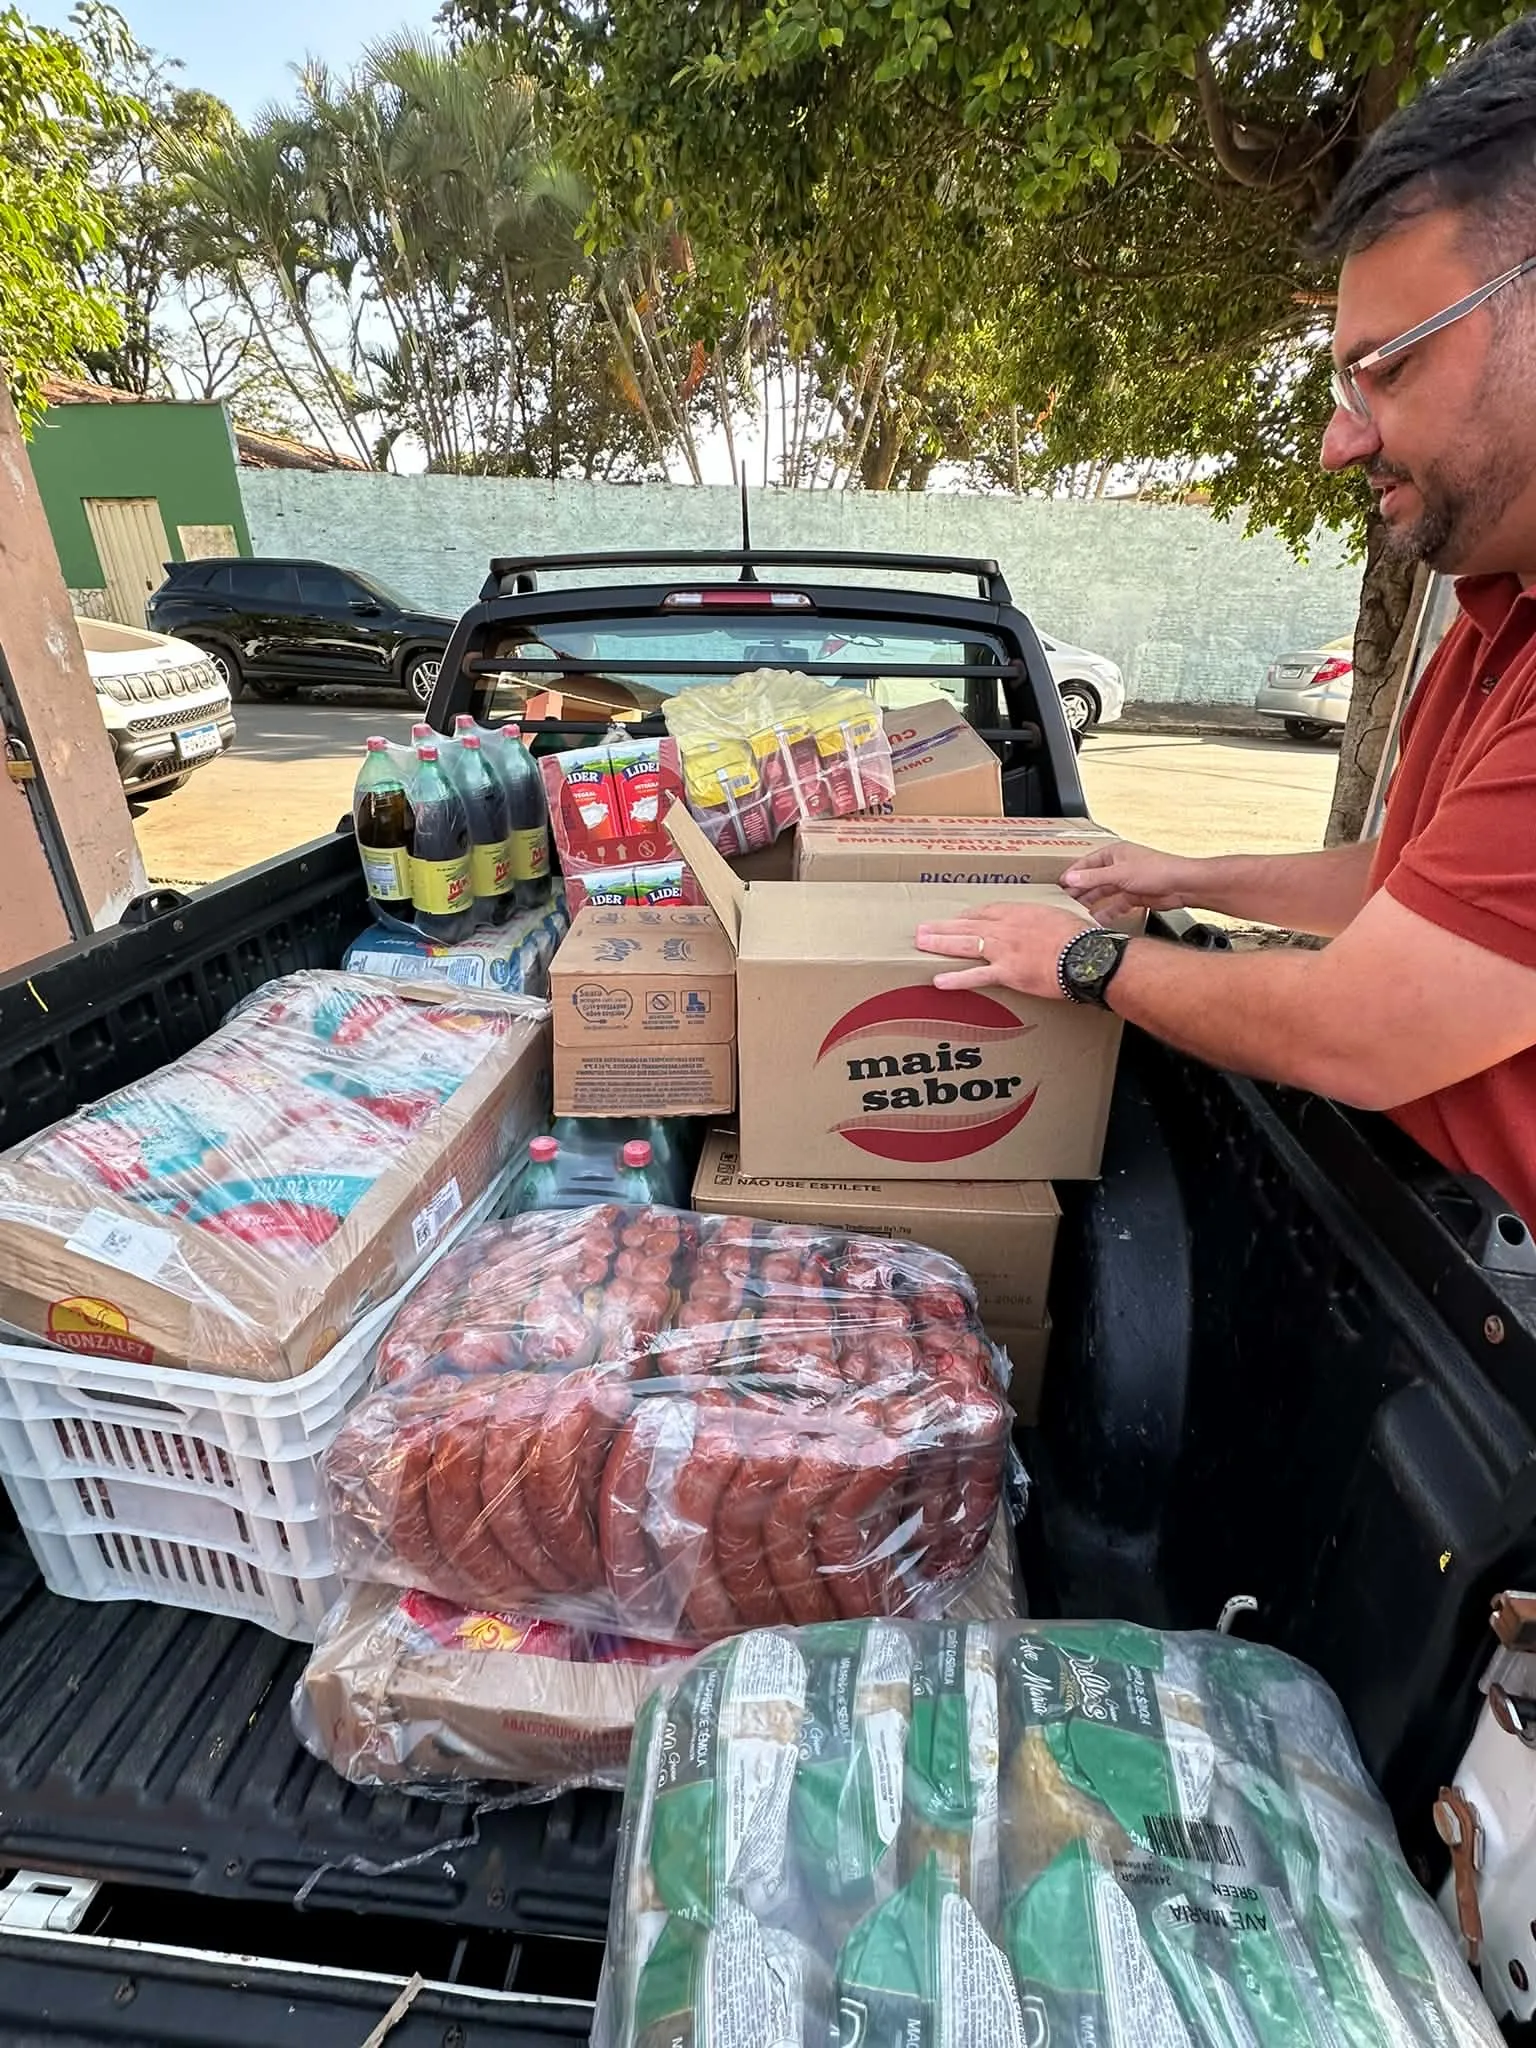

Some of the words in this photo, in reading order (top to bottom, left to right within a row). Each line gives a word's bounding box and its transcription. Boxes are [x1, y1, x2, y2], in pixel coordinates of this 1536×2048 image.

[566, 771, 599, 785] IDER
[626, 762, 660, 778] LIDE
[591, 894, 622, 906] IDER
[650, 888, 682, 902] LIDE
[846, 1042, 982, 1081] mais
[862, 1076, 1022, 1112] sabor
[775, 1180, 804, 1190] USE
[809, 1182, 882, 1193] ESTILETE
[54, 1331, 147, 1360] GONZALEZ
[1020, 1638, 1045, 1661] Ave
[1020, 1661, 1055, 1717] Maria
[1211, 1882, 1259, 1902] GREEN
[1169, 1903, 1230, 1930] MARIA
[1229, 1911, 1268, 1932] AVE
